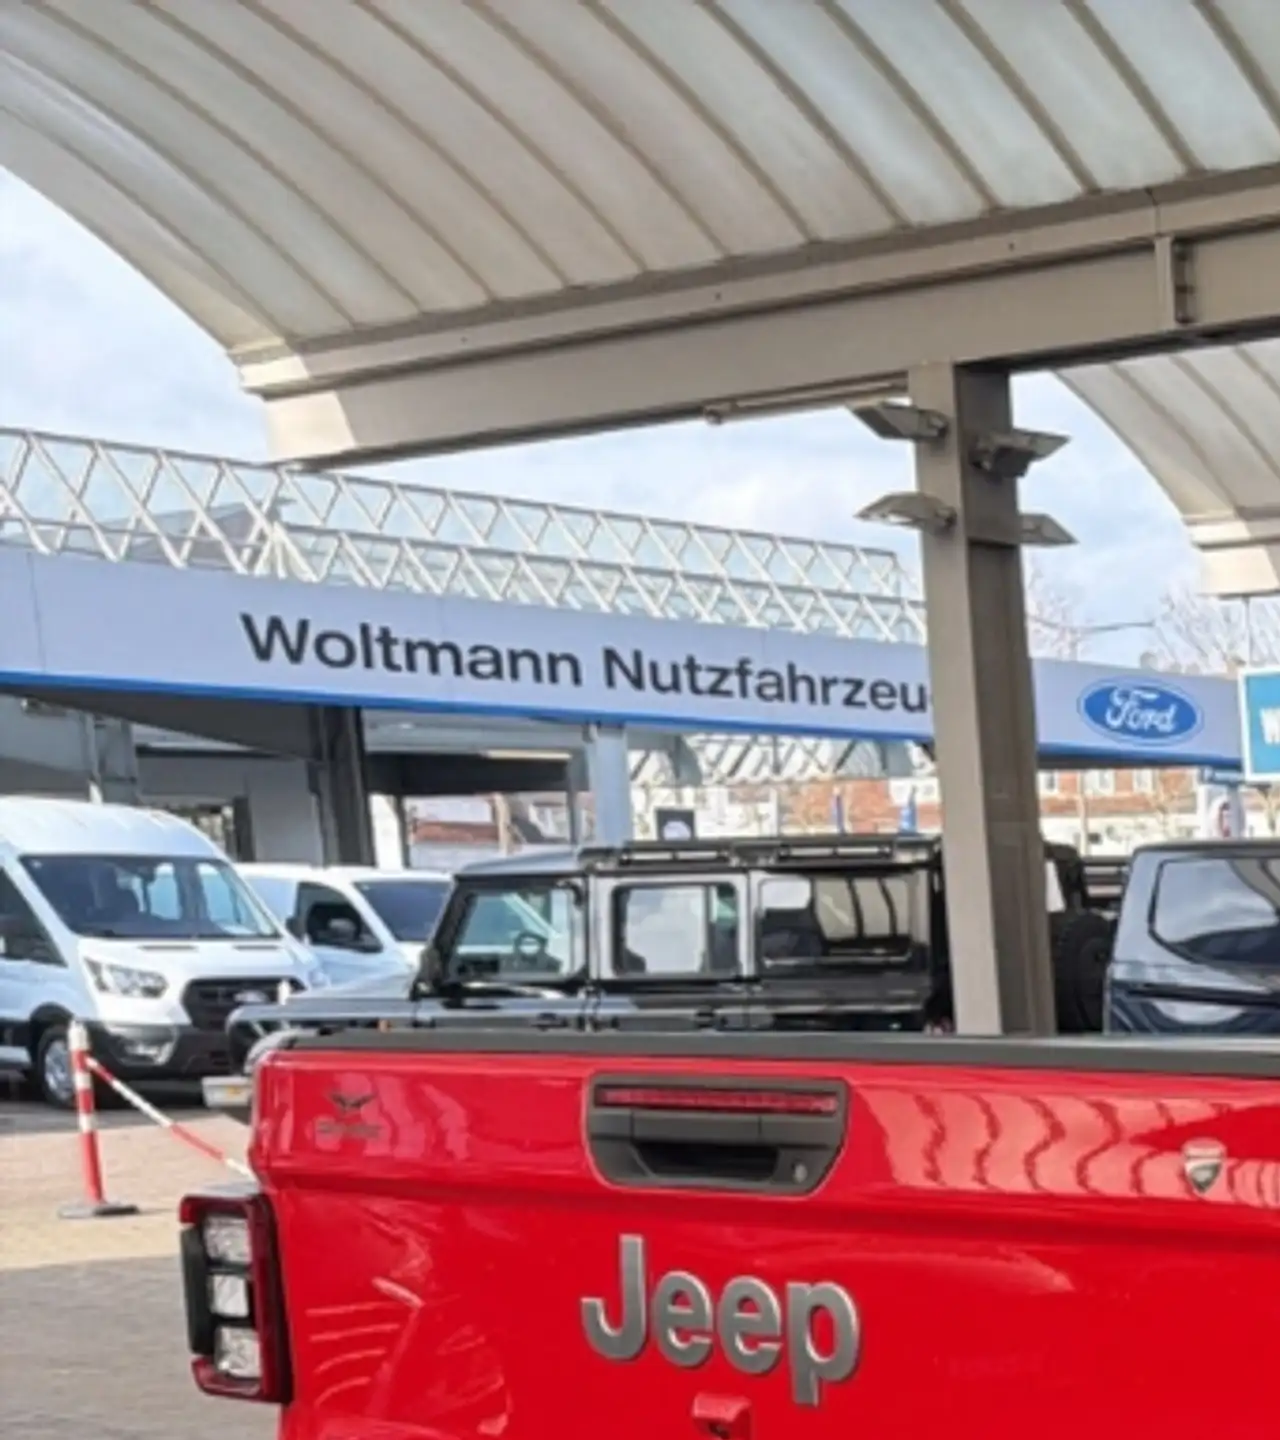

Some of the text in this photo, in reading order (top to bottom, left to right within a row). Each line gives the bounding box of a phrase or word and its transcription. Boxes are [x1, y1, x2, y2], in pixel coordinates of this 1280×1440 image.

[240, 612, 931, 713] Woltmann Nutzfahrzeu
[1105, 687, 1177, 732] Ford
[580, 1233, 860, 1408] Jeep
